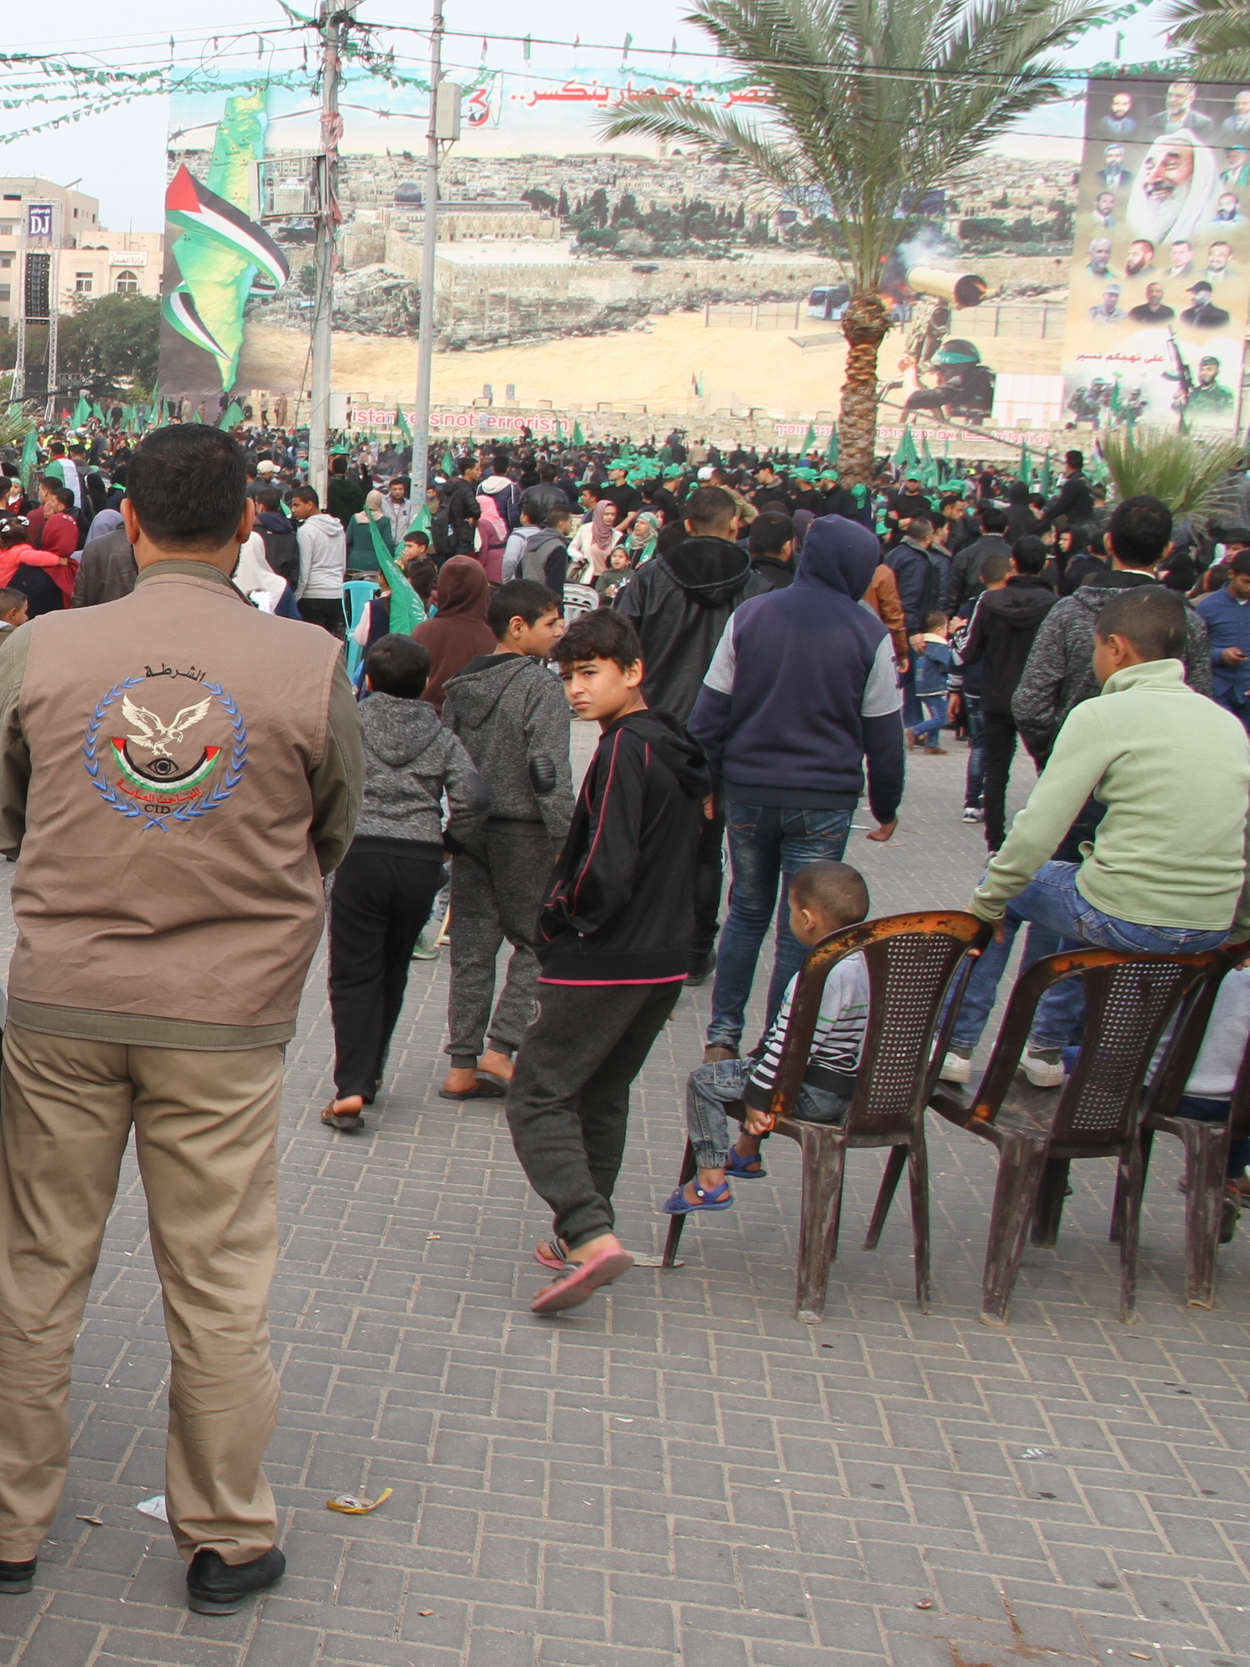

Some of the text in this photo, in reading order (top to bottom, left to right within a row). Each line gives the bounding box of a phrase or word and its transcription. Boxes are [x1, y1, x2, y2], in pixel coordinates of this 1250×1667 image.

[30, 215, 51, 234] DJ
[1143, 353, 1164, 364] على
[444, 410, 474, 428] not
[478, 412, 568, 431] errorism
[143, 662, 208, 683] الشرطة
[144, 803, 171, 814] CID
